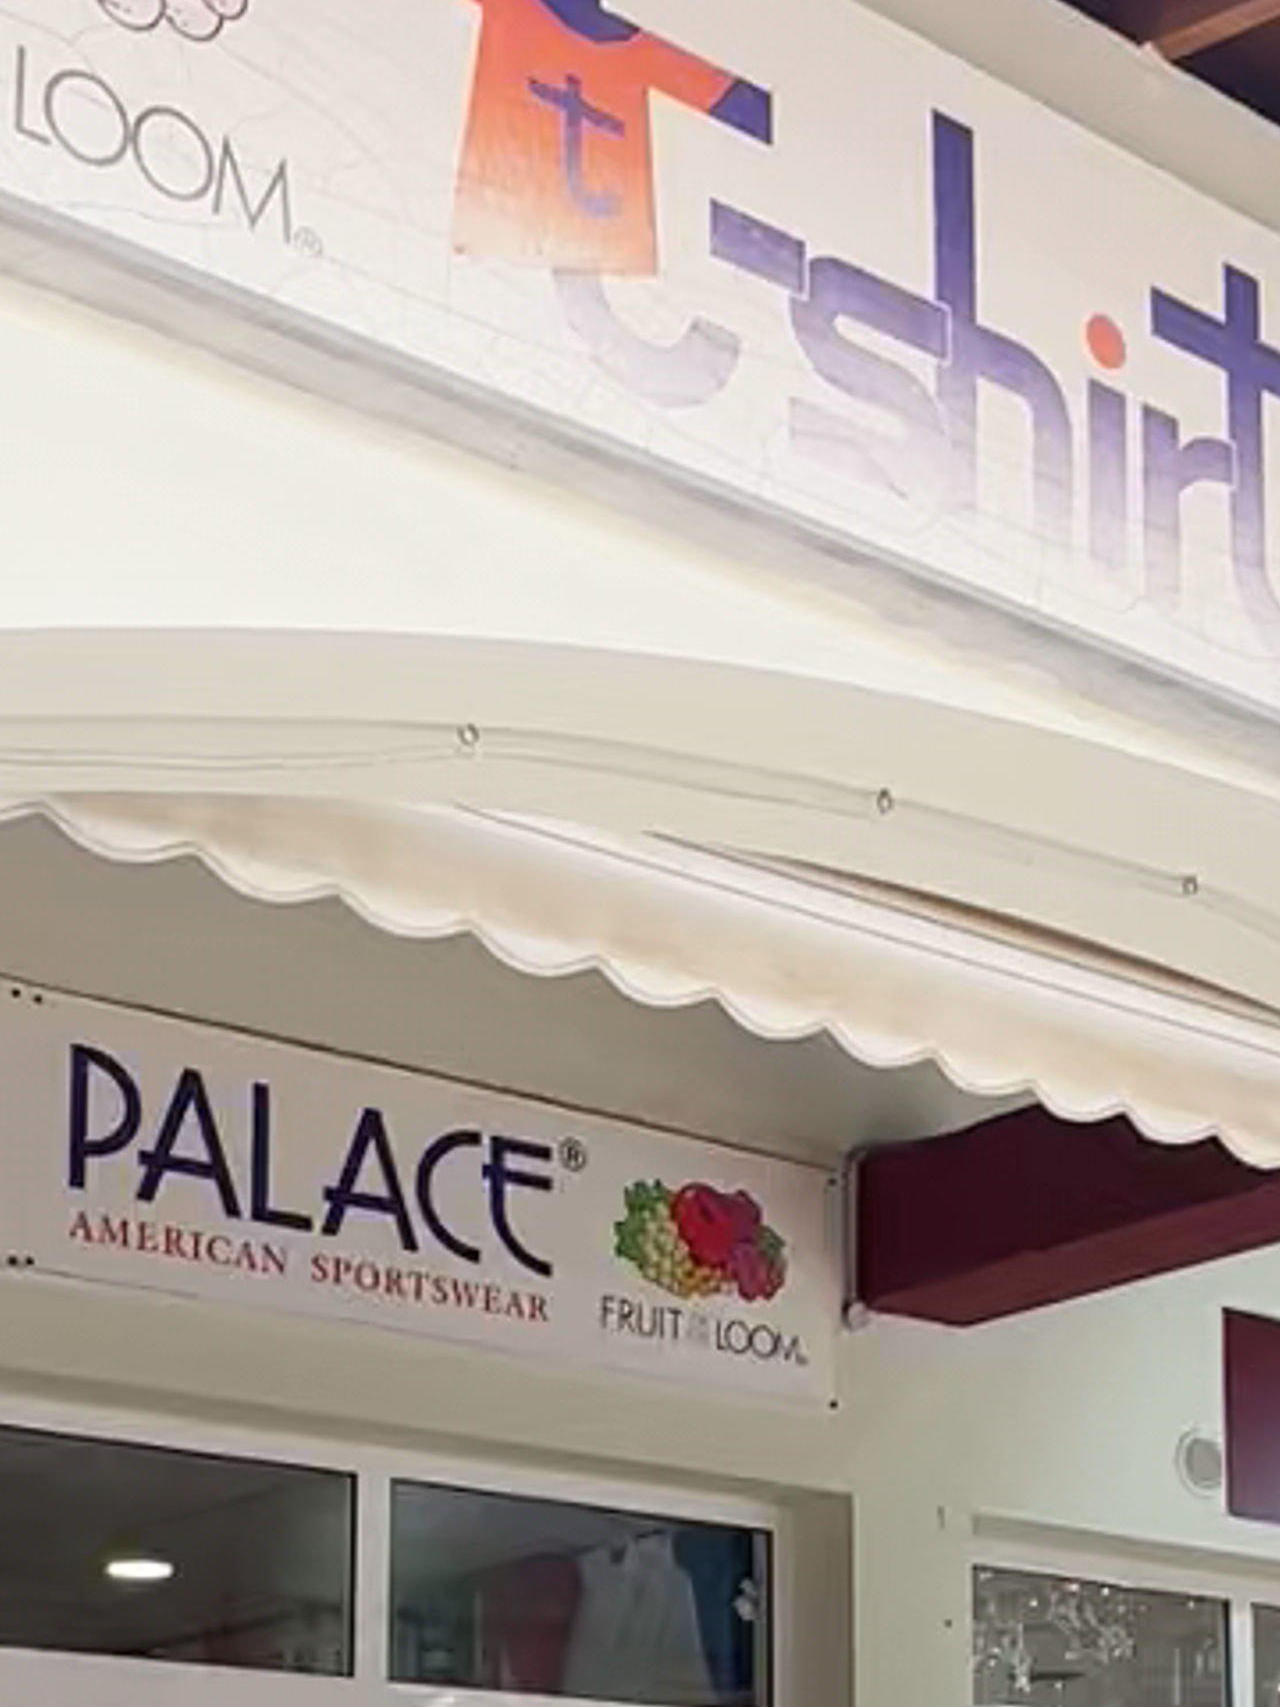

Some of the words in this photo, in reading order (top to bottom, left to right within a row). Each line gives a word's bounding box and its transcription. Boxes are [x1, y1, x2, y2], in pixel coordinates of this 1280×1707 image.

[68, 1210, 288, 1276] AMERICAN
[309, 1249, 551, 1323] SPORTSWEAR
[600, 1295, 683, 1341] FRUIT
